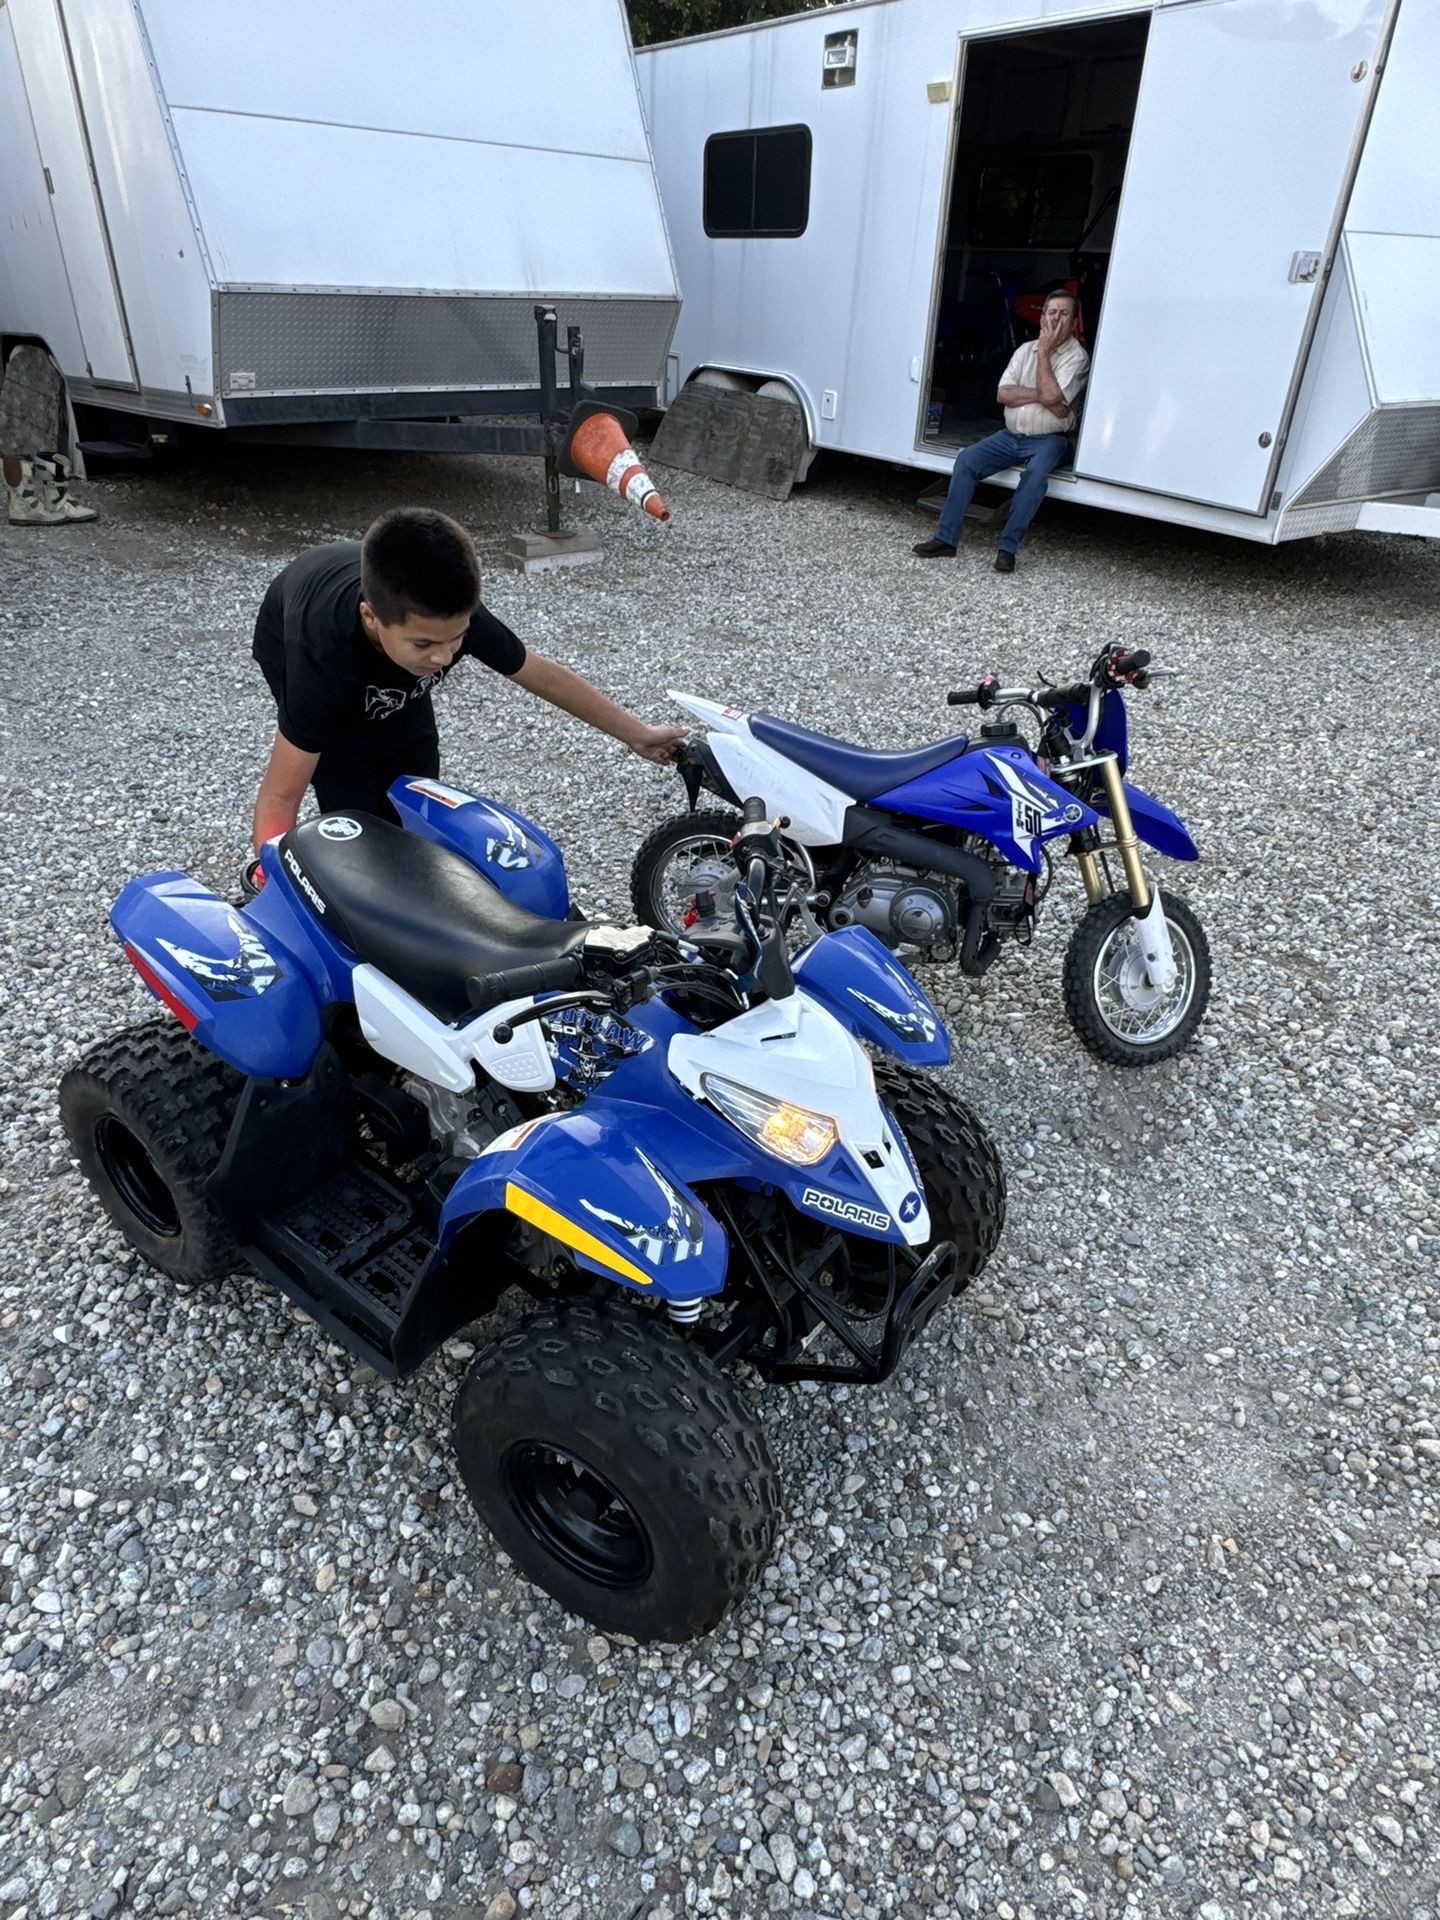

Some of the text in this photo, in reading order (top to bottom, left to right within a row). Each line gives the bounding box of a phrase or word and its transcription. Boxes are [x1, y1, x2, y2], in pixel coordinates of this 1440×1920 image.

[1025, 804, 1042, 837] 50
[284, 848, 327, 914] POLARIS
[551, 1023, 577, 1036] 50
[803, 1188, 890, 1231] POLARIS
